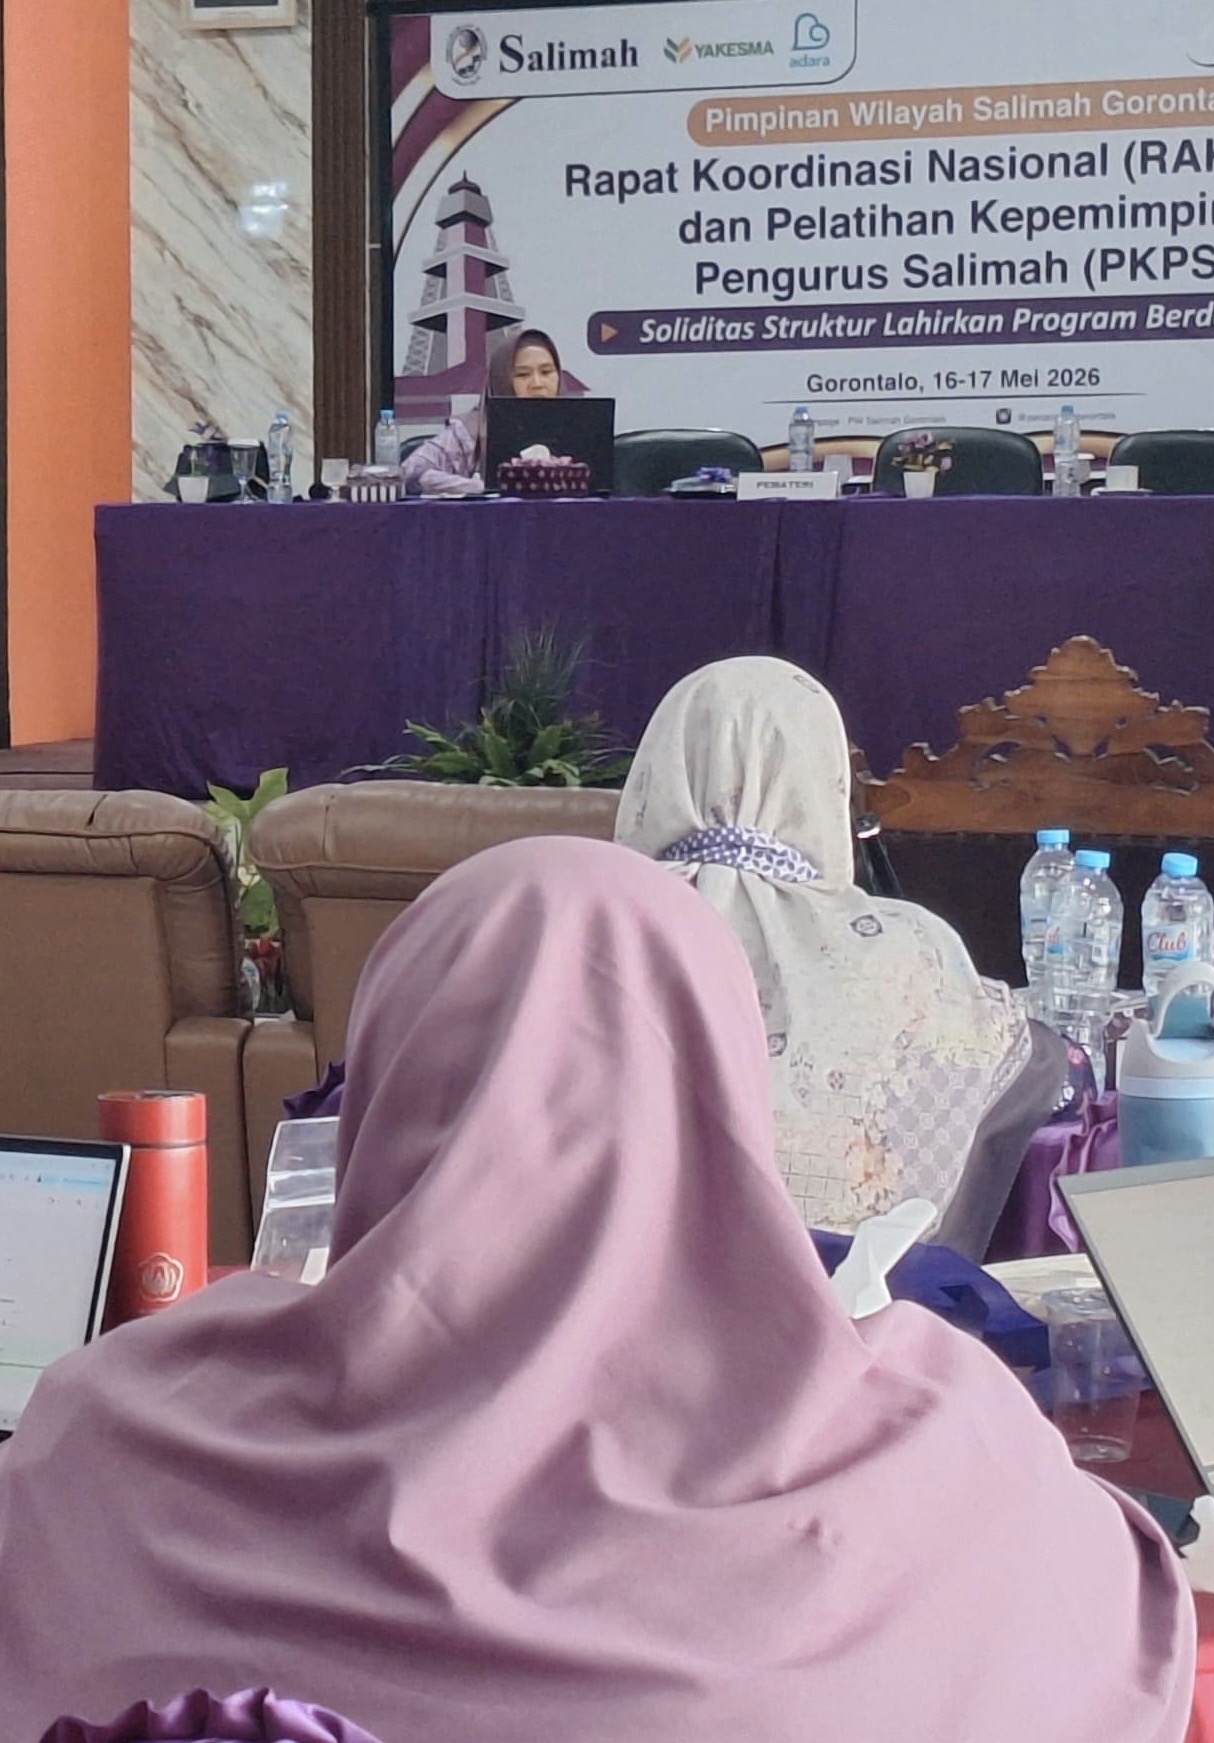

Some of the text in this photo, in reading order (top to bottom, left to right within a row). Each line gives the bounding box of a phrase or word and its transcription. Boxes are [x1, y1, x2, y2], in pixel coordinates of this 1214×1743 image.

[500, 34, 639, 74] Salimah
[695, 41, 775, 59] YAKESMA
[789, 54, 831, 69] adara
[706, 105, 839, 136] Pimpinan
[848, 97, 963, 130] Wilayah
[973, 91, 1091, 121] Salimah
[565, 161, 679, 204] Rapat
[693, 151, 912, 192] Koordinasi
[928, 142, 1108, 183] Nasional
[678, 210, 751, 245] dan
[768, 204, 954, 242] Pelatihan
[695, 261, 889, 301] Pengurus
[903, 250, 1068, 289] Salimah
[639, 316, 756, 343] Soliditas
[761, 313, 878, 340] Struktur
[883, 308, 1004, 336] Lahirkan
[1012, 308, 1137, 337] Program
[806, 367, 1101, 394] Gorontalo, 16-17 Mei 2026
[1147, 931, 1187, 954] Club
